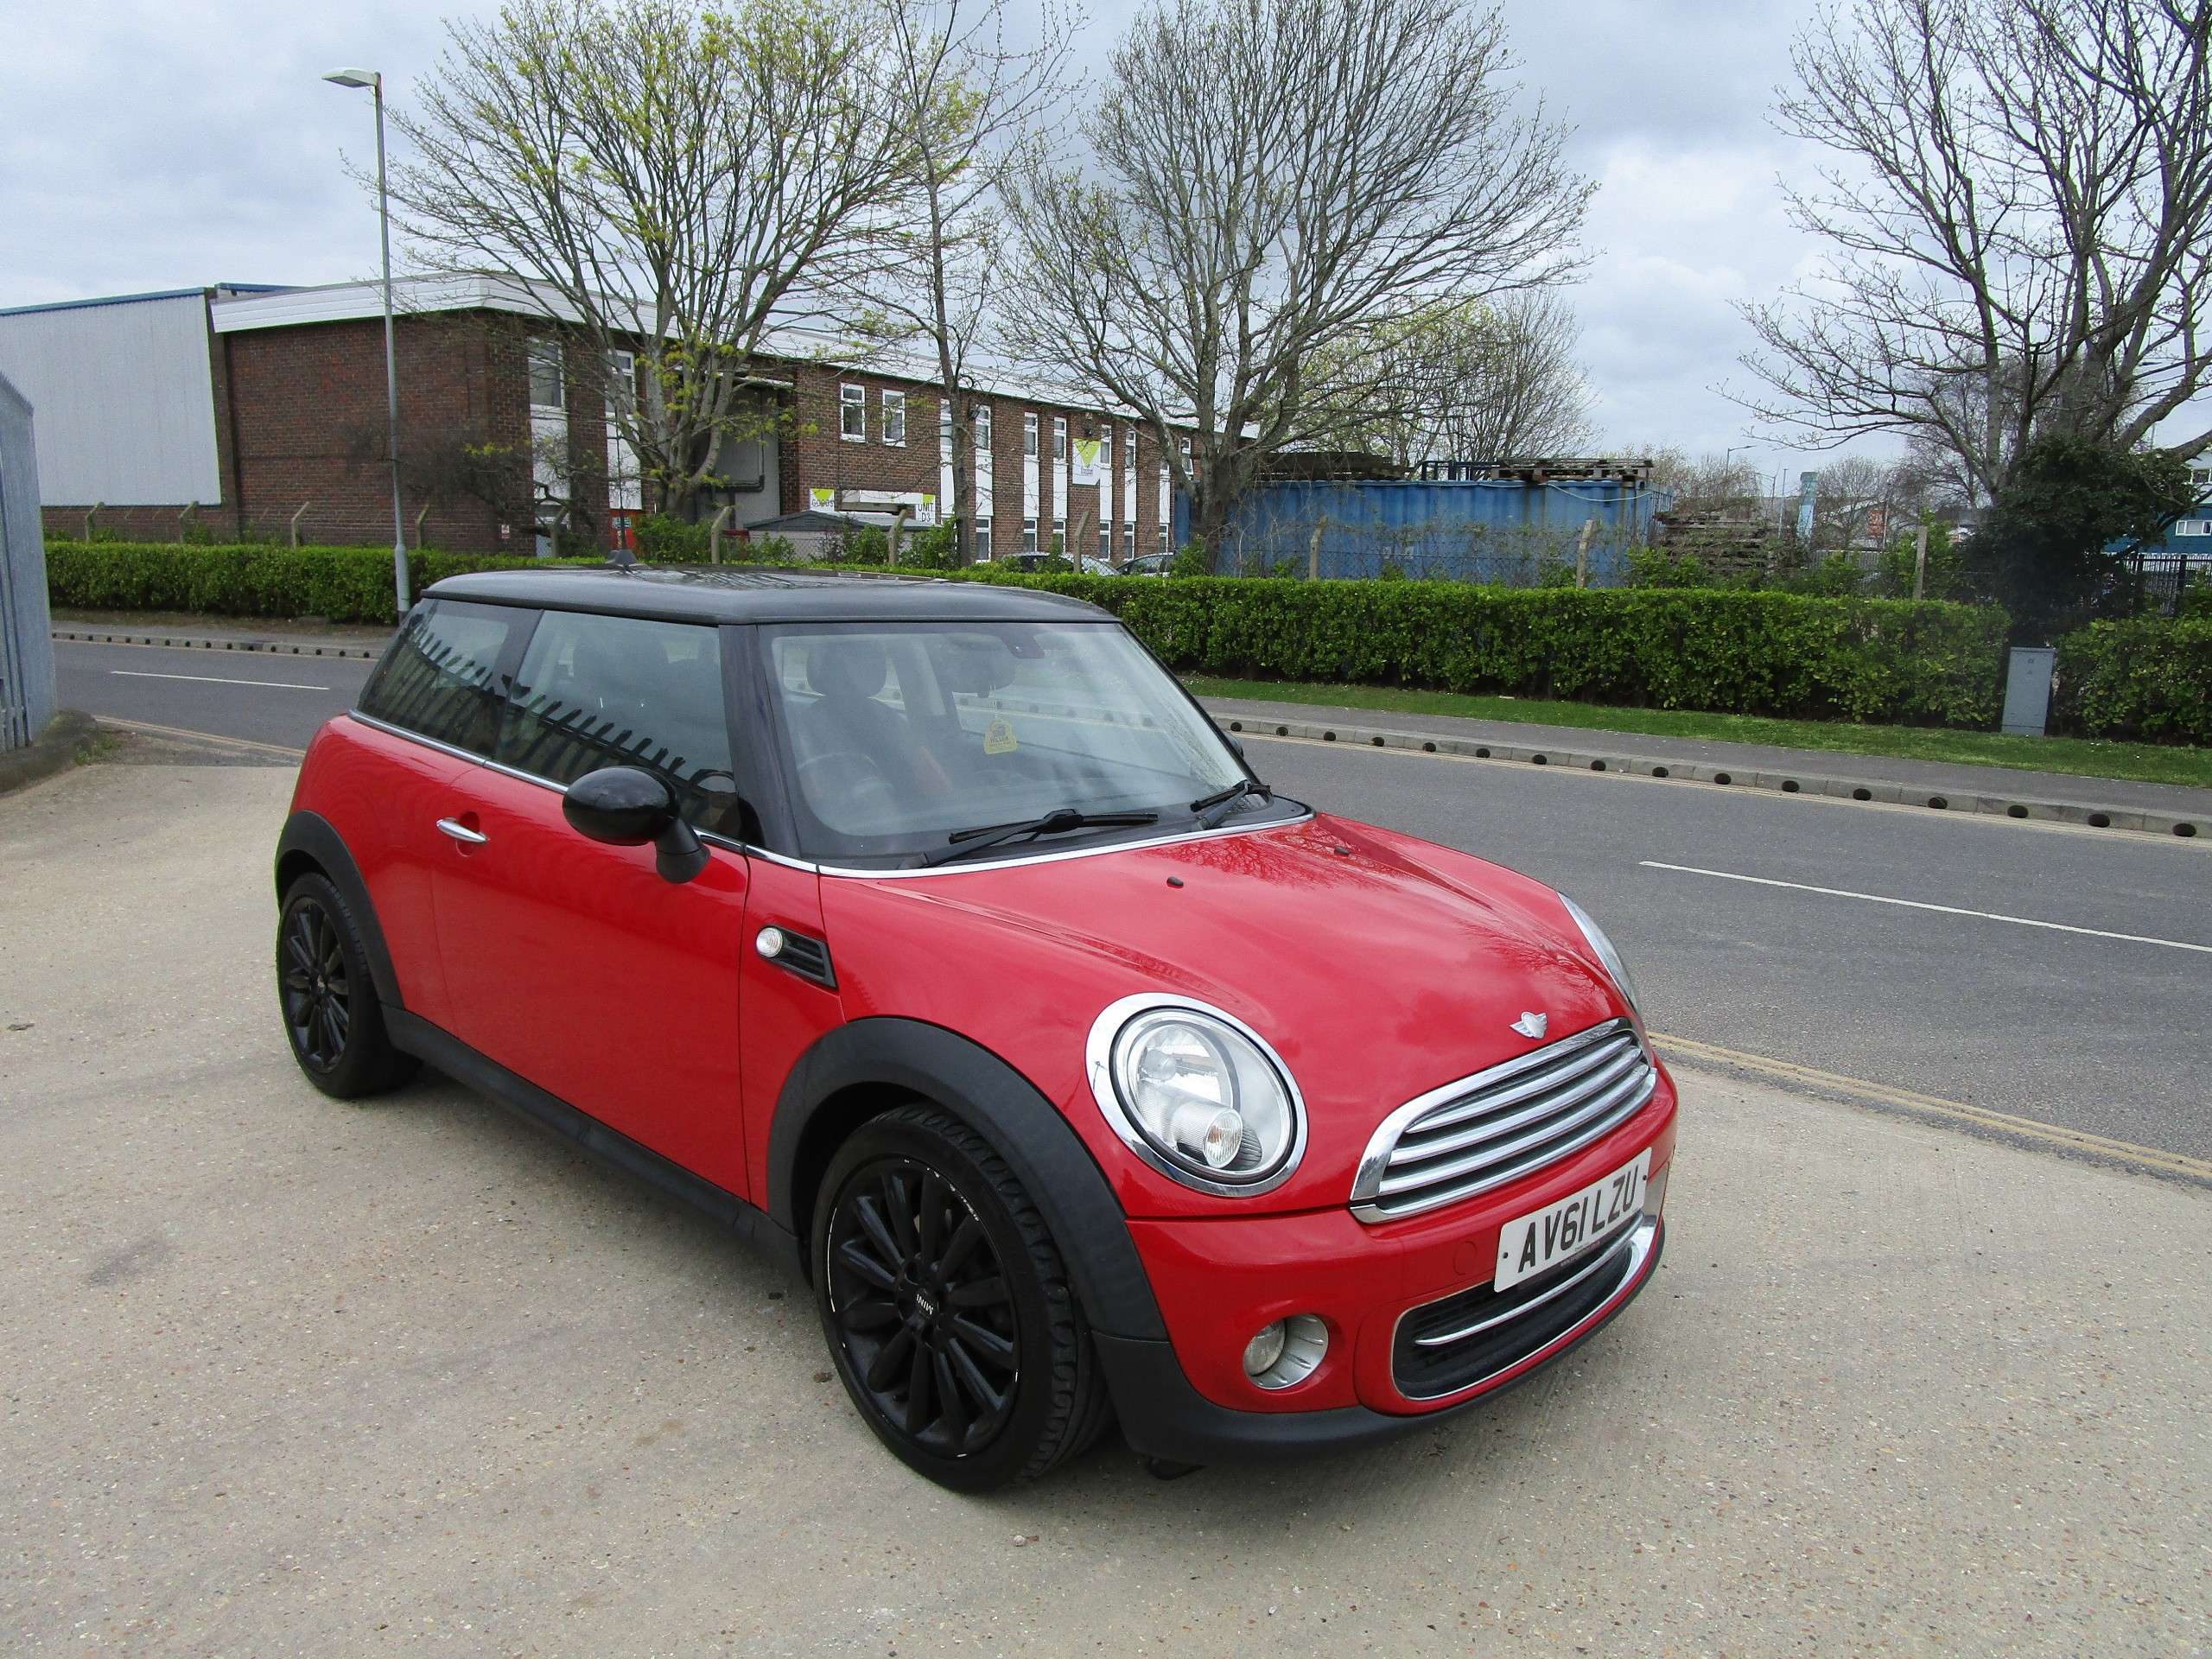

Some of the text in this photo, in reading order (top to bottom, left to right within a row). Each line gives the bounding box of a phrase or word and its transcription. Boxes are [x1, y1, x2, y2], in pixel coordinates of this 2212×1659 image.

[918, 503, 933, 512] UNIT
[921, 513, 931, 523] D3
[1518, 1165, 1639, 1273] AV61 LZU
[916, 1294, 934, 1315] MINI
